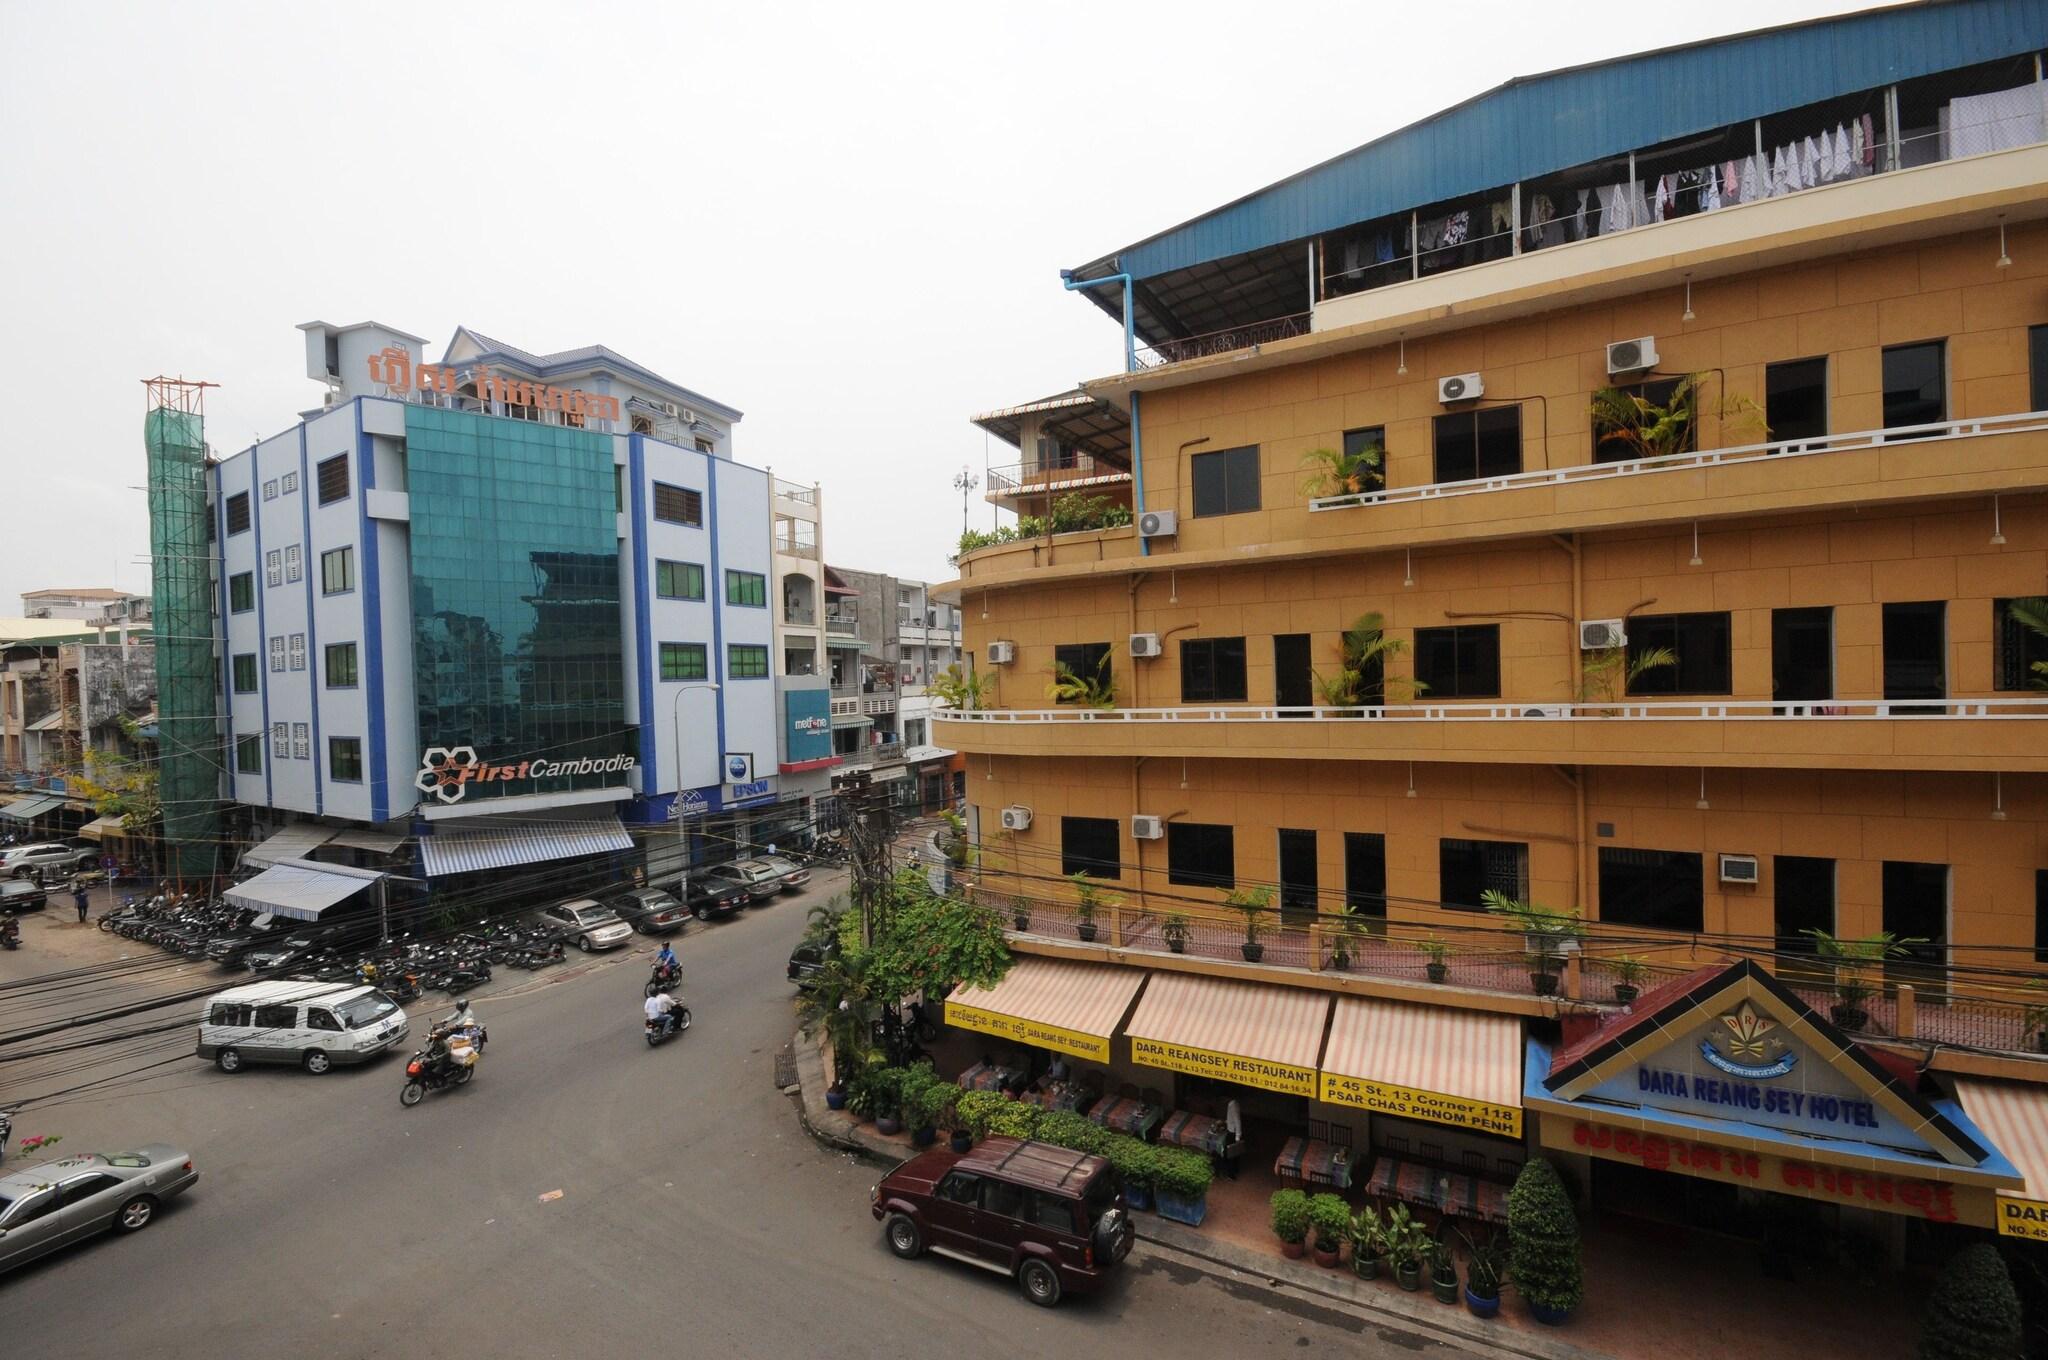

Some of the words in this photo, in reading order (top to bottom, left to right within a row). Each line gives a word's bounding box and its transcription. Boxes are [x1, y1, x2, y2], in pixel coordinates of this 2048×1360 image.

[459, 761, 530, 783] First
[530, 754, 635, 778] Cambodia
[733, 780, 768, 798] EPSON
[1027, 1028, 1040, 1040] DARA
[1057, 1035, 1067, 1045] SEY
[1069, 1038, 1101, 1053] RESTAURANT
[1136, 1042, 1164, 1056] DARA
[1168, 1048, 1229, 1068] REANGSEY
[1233, 1060, 1312, 1083] RESTAURANT
[1327, 1089, 1364, 1104] PSAR
[1367, 1097, 1407, 1112] CHAS
[1411, 1105, 1466, 1123] PHNOM
[1471, 1116, 1513, 1133] PENH
[1342, 1081, 1360, 1091] 45
[1366, 1085, 1386, 1097] St.
[1393, 1090, 1411, 1101] 13
[1417, 1095, 1475, 1113] Corner
[1481, 1106, 1513, 1121] 118
[1638, 1067, 1689, 1099] DARA
[1694, 1076, 1761, 1110] REANG
[1763, 1086, 1806, 1118] SEY
[1809, 1096, 1880, 1129] HOTEL
[2033, 1228, 2048, 1238] 45
